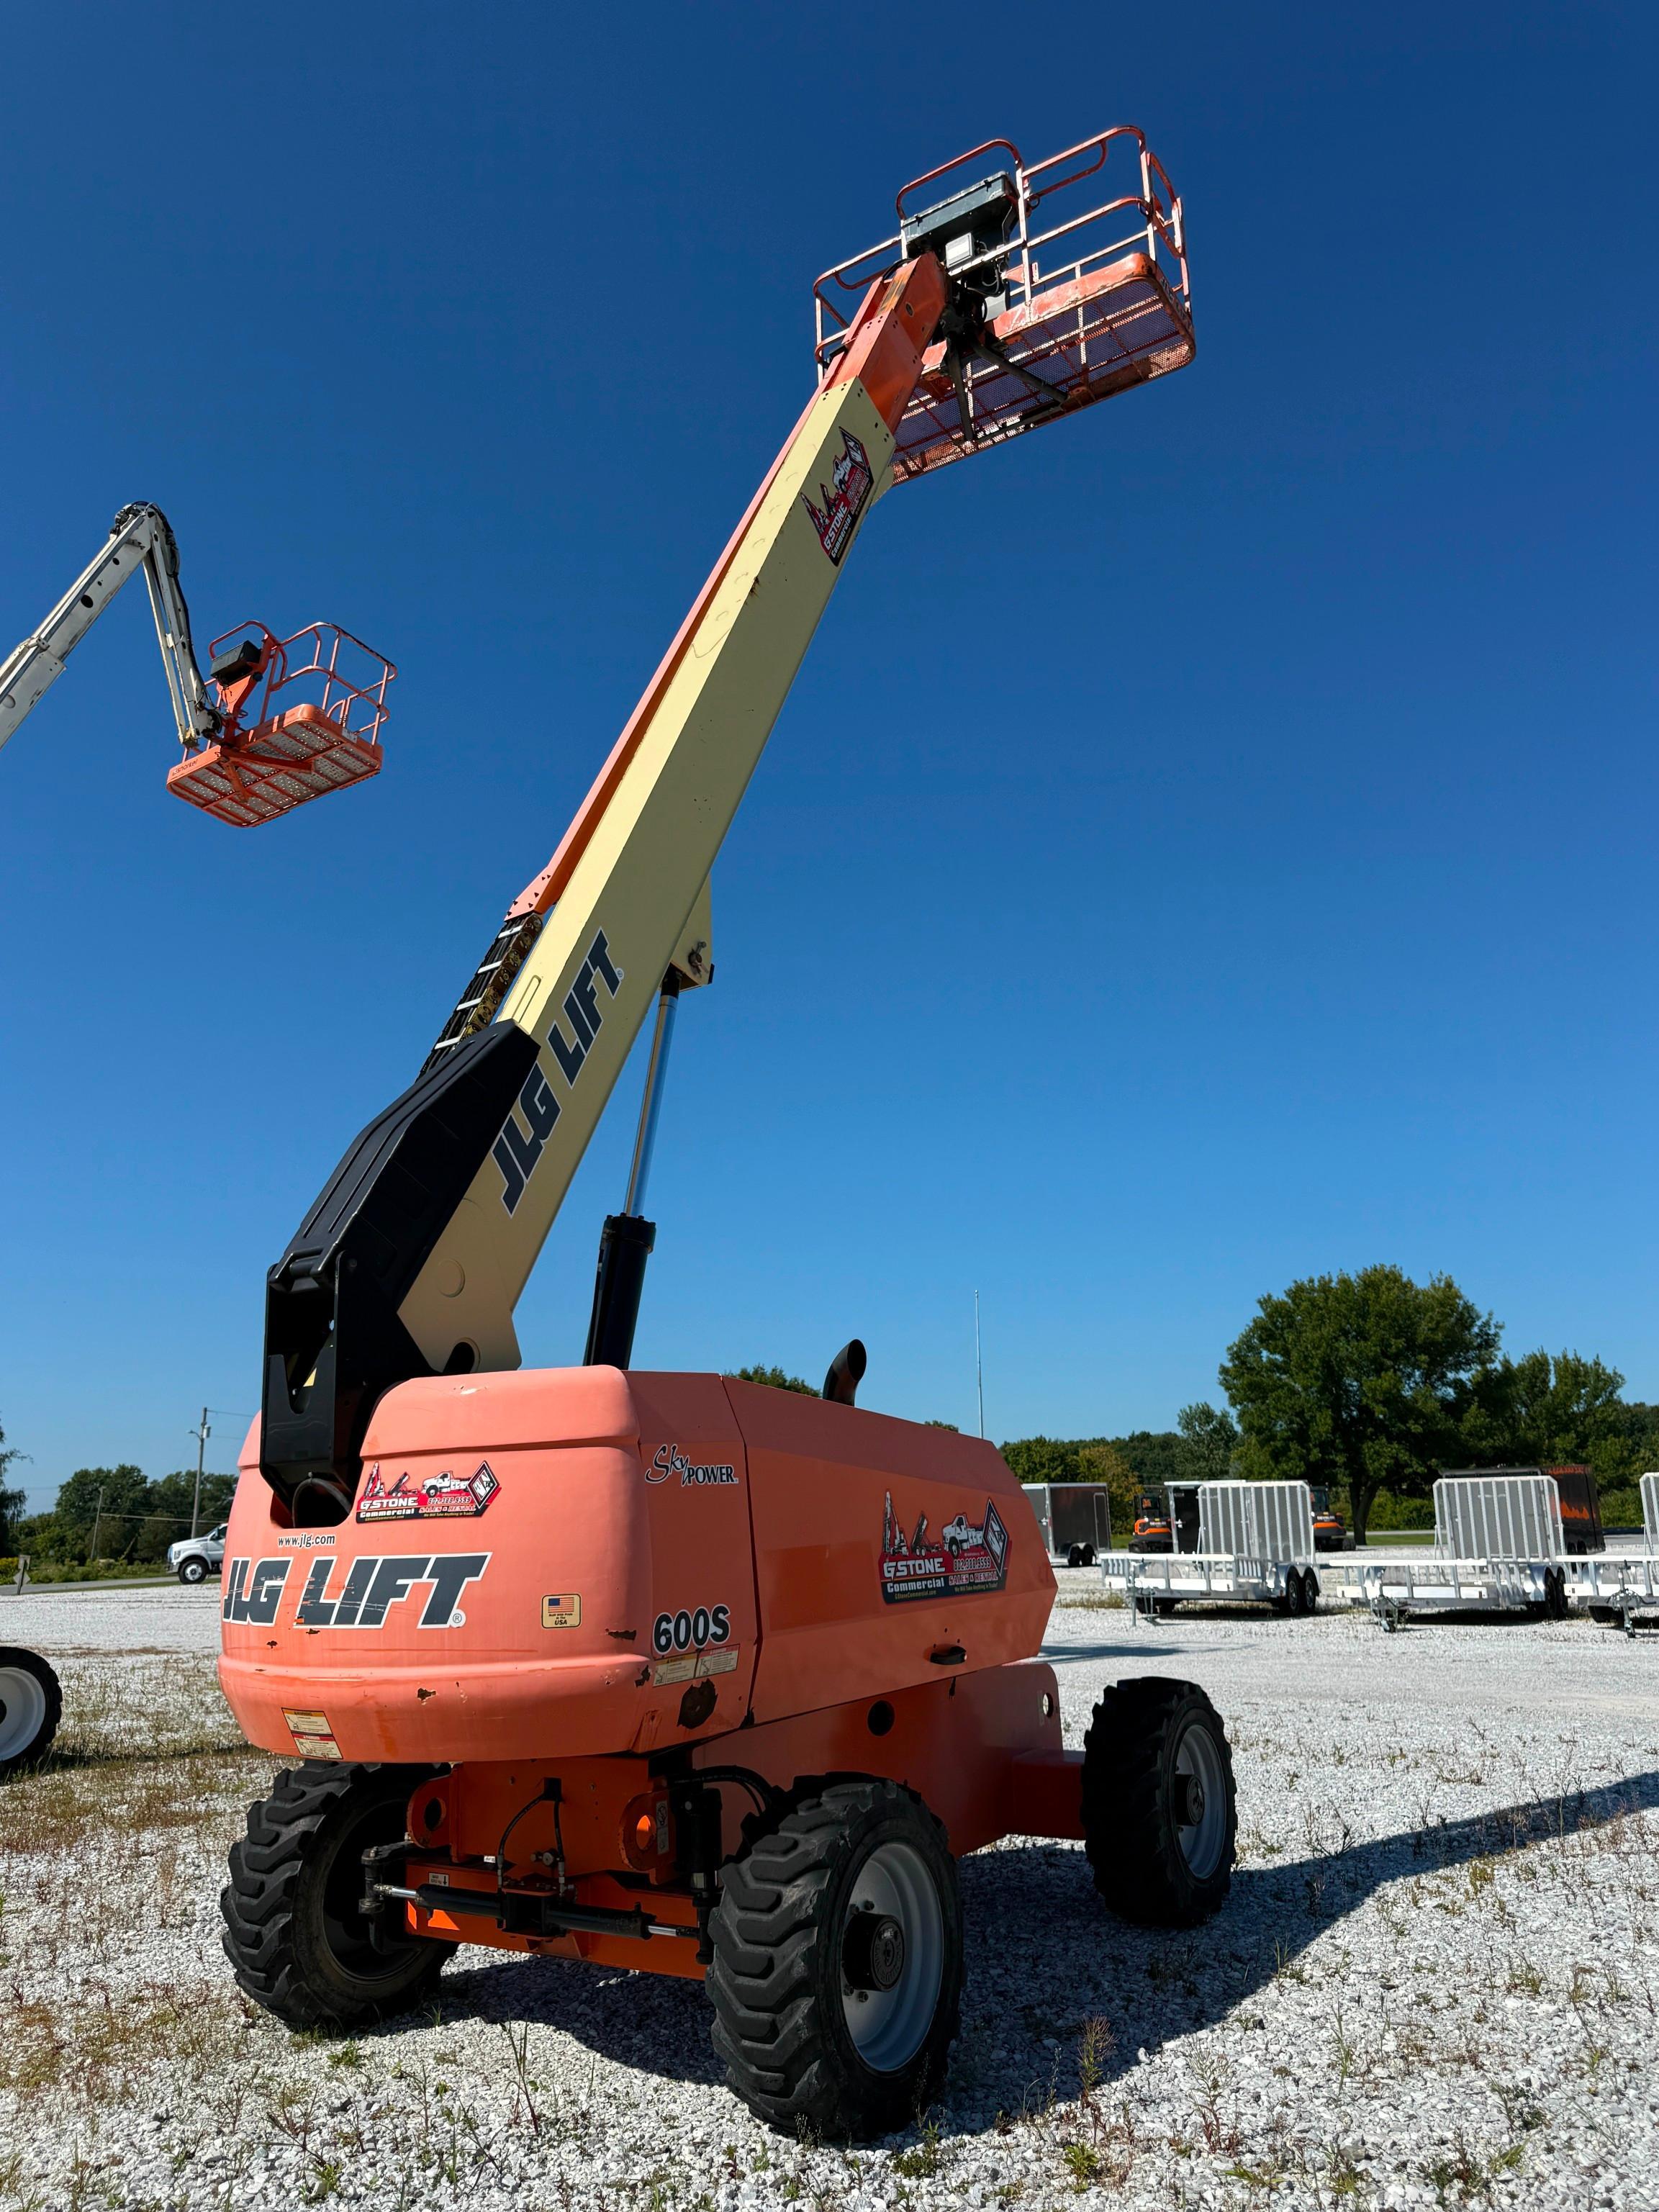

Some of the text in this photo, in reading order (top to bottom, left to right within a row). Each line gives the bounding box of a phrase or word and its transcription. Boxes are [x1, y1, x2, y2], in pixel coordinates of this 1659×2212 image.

[823, 502, 847, 550] GSTONE
[831, 514, 852, 559] Commercial
[491, 926, 622, 1219] JLG LIFT
[645, 1444, 690, 1487] Sky
[360, 1497, 418, 1511] GSTONE
[360, 1508, 415, 1519] Commercial
[278, 1533, 336, 1549] www.jlg.com
[883, 1558, 946, 1579] GSTONE
[887, 1577, 945, 1593] Commercial
[222, 1553, 493, 1630] JLG LIFT
[653, 1604, 731, 1655] 600S
